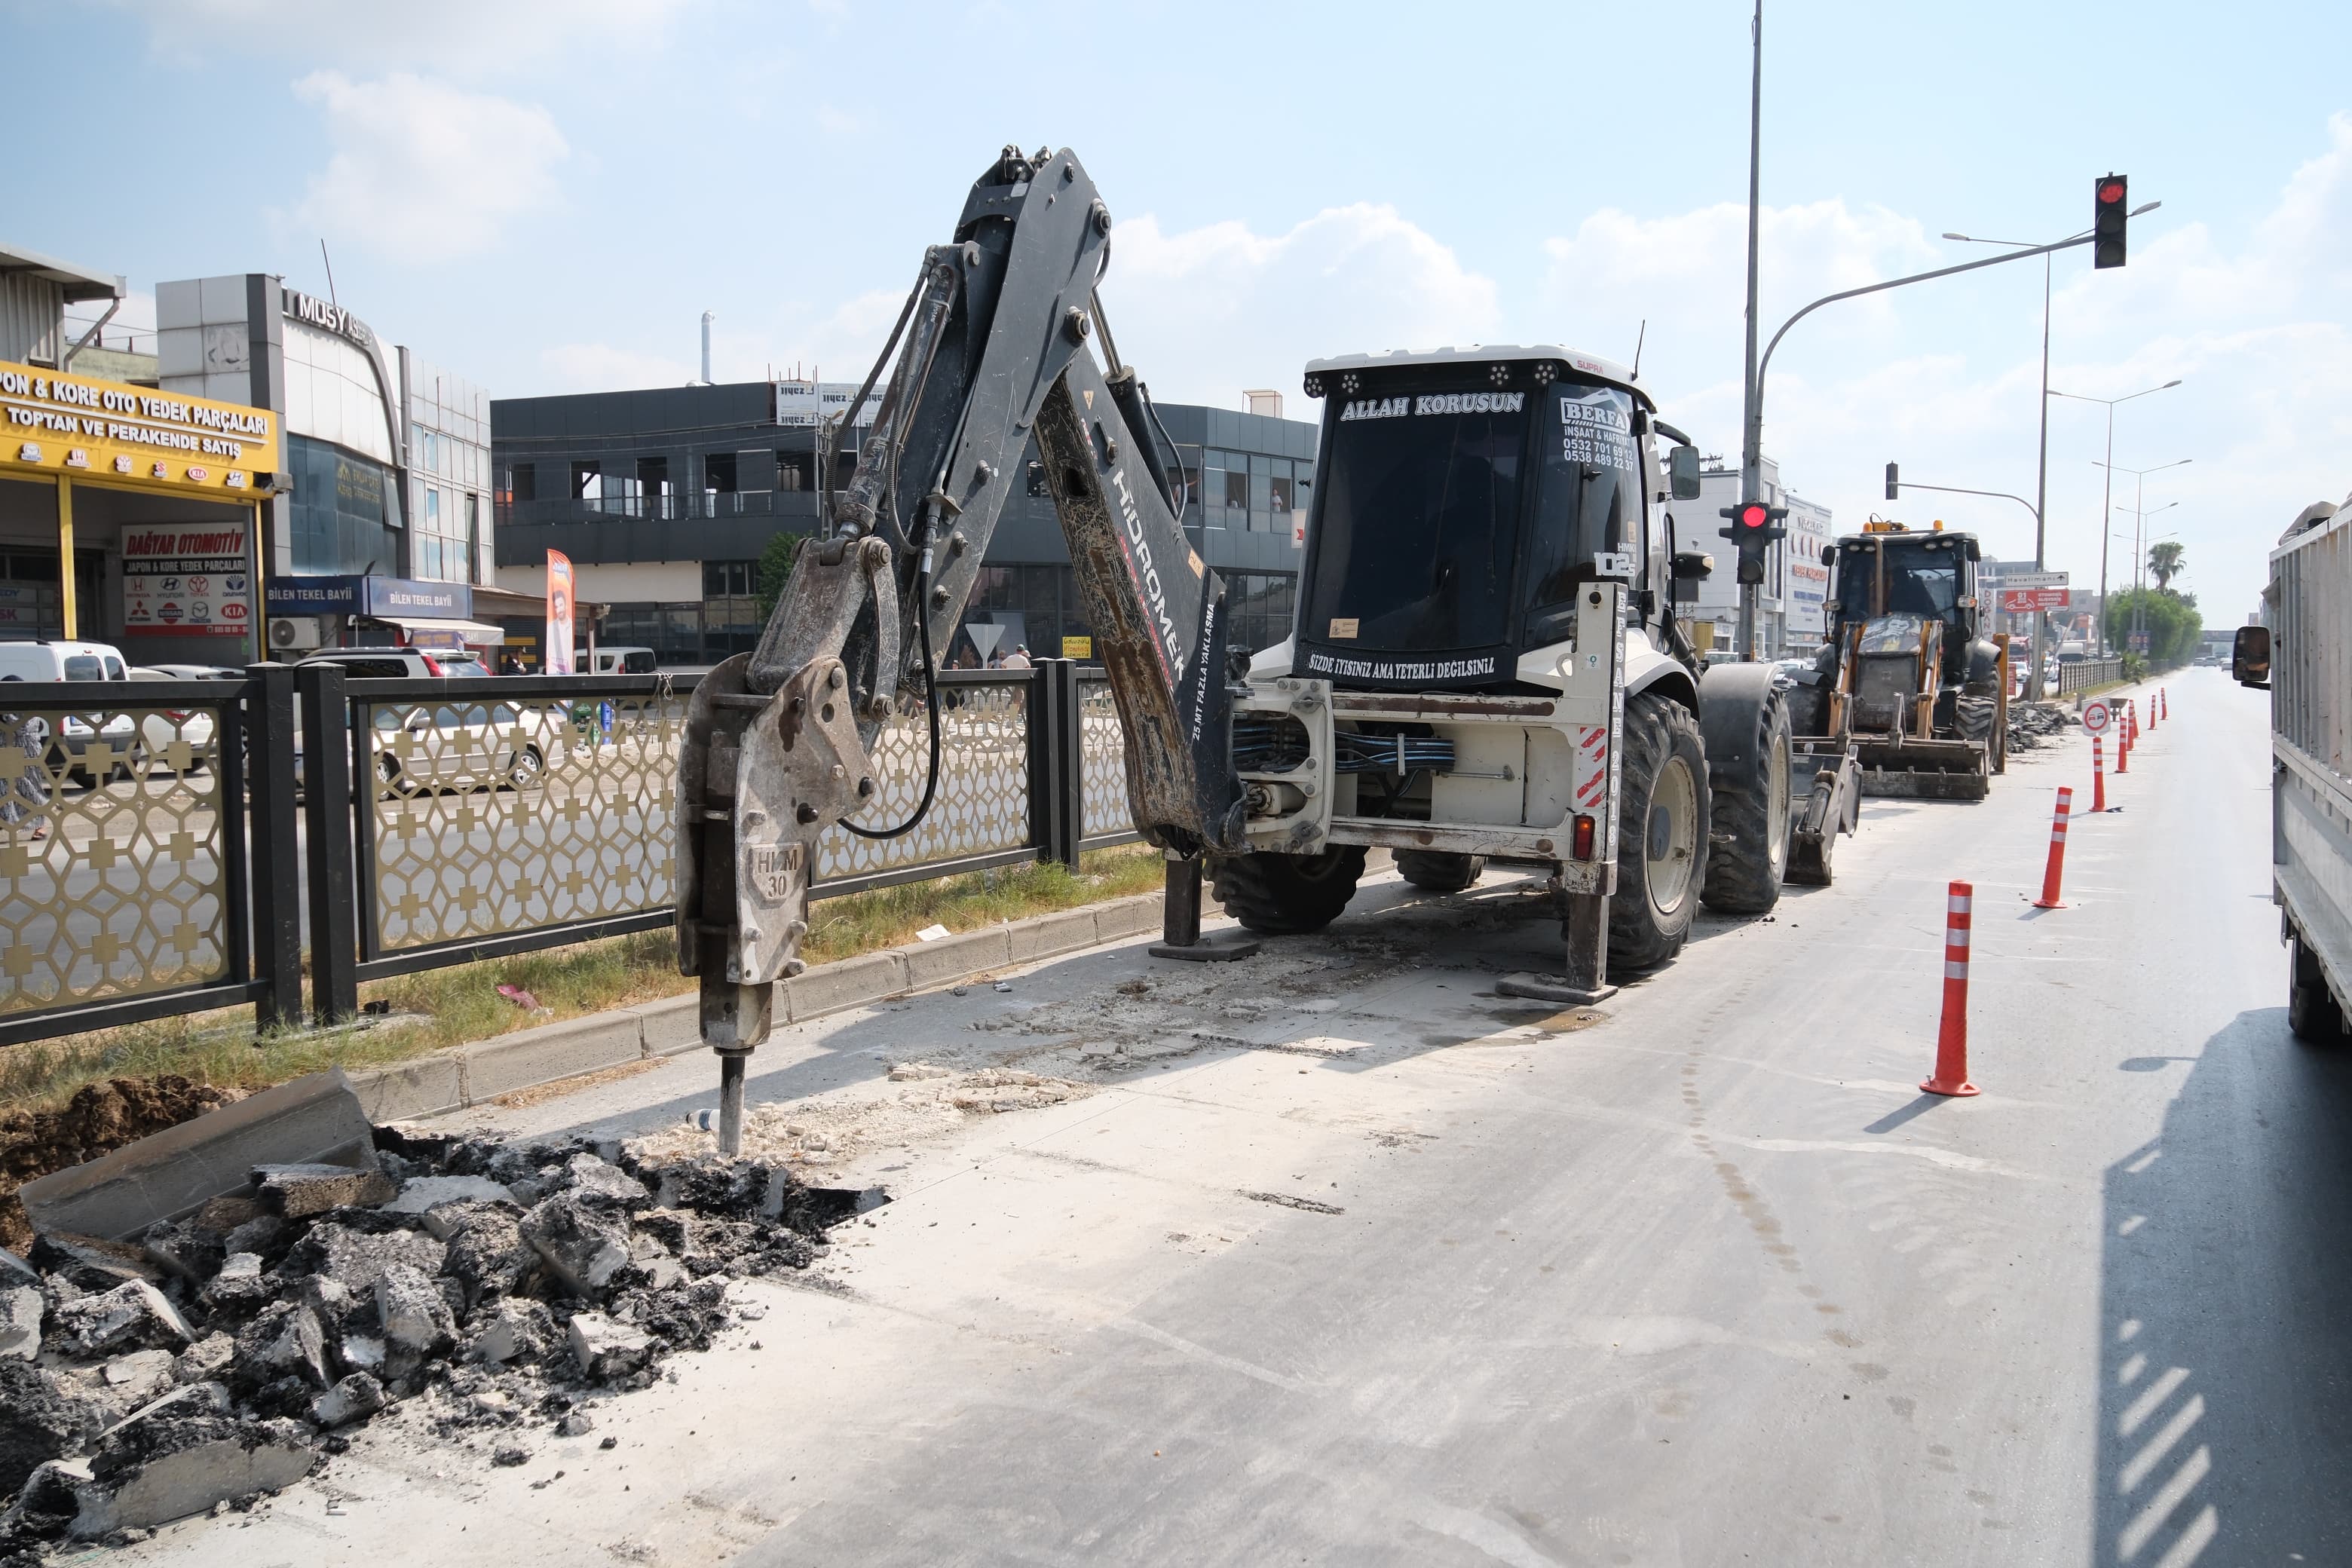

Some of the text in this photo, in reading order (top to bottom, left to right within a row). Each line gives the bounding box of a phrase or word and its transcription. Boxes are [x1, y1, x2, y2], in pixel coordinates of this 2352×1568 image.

[1577, 360, 1603, 374] SUPRA
[0, 372, 268, 435] ON & KORE OTO YEDEK PARÇALARI
[1340, 392, 1524, 421] ALLAH KORUSUN
[1566, 403, 1626, 429] BERFA
[8, 406, 241, 459] TOPTAN VE PERAKENDE SATIŞ
[1597, 430, 1602, 439] &
[1563, 439, 1633, 460] 0532 701 69 12
[1564, 450, 1634, 472] 0538 489 22 37
[191, 471, 206, 479] KIA
[127, 528, 244, 556] DAĞYAR OTOMOTİV
[127, 559, 245, 573] JAPON & KORE YEDEK PARÇALARI
[268, 587, 295, 600] BİLEN
[297, 590, 325, 600] TEKEL
[390, 592, 411, 604] BİLEN
[412, 594, 433, 605] TEKEL
[224, 607, 244, 616] KIA
[1193, 604, 1214, 742] 25 MT FAZLA YAKLAŞMA
[1372, 663, 1394, 679] AMA
[767, 875, 787, 897] 30
